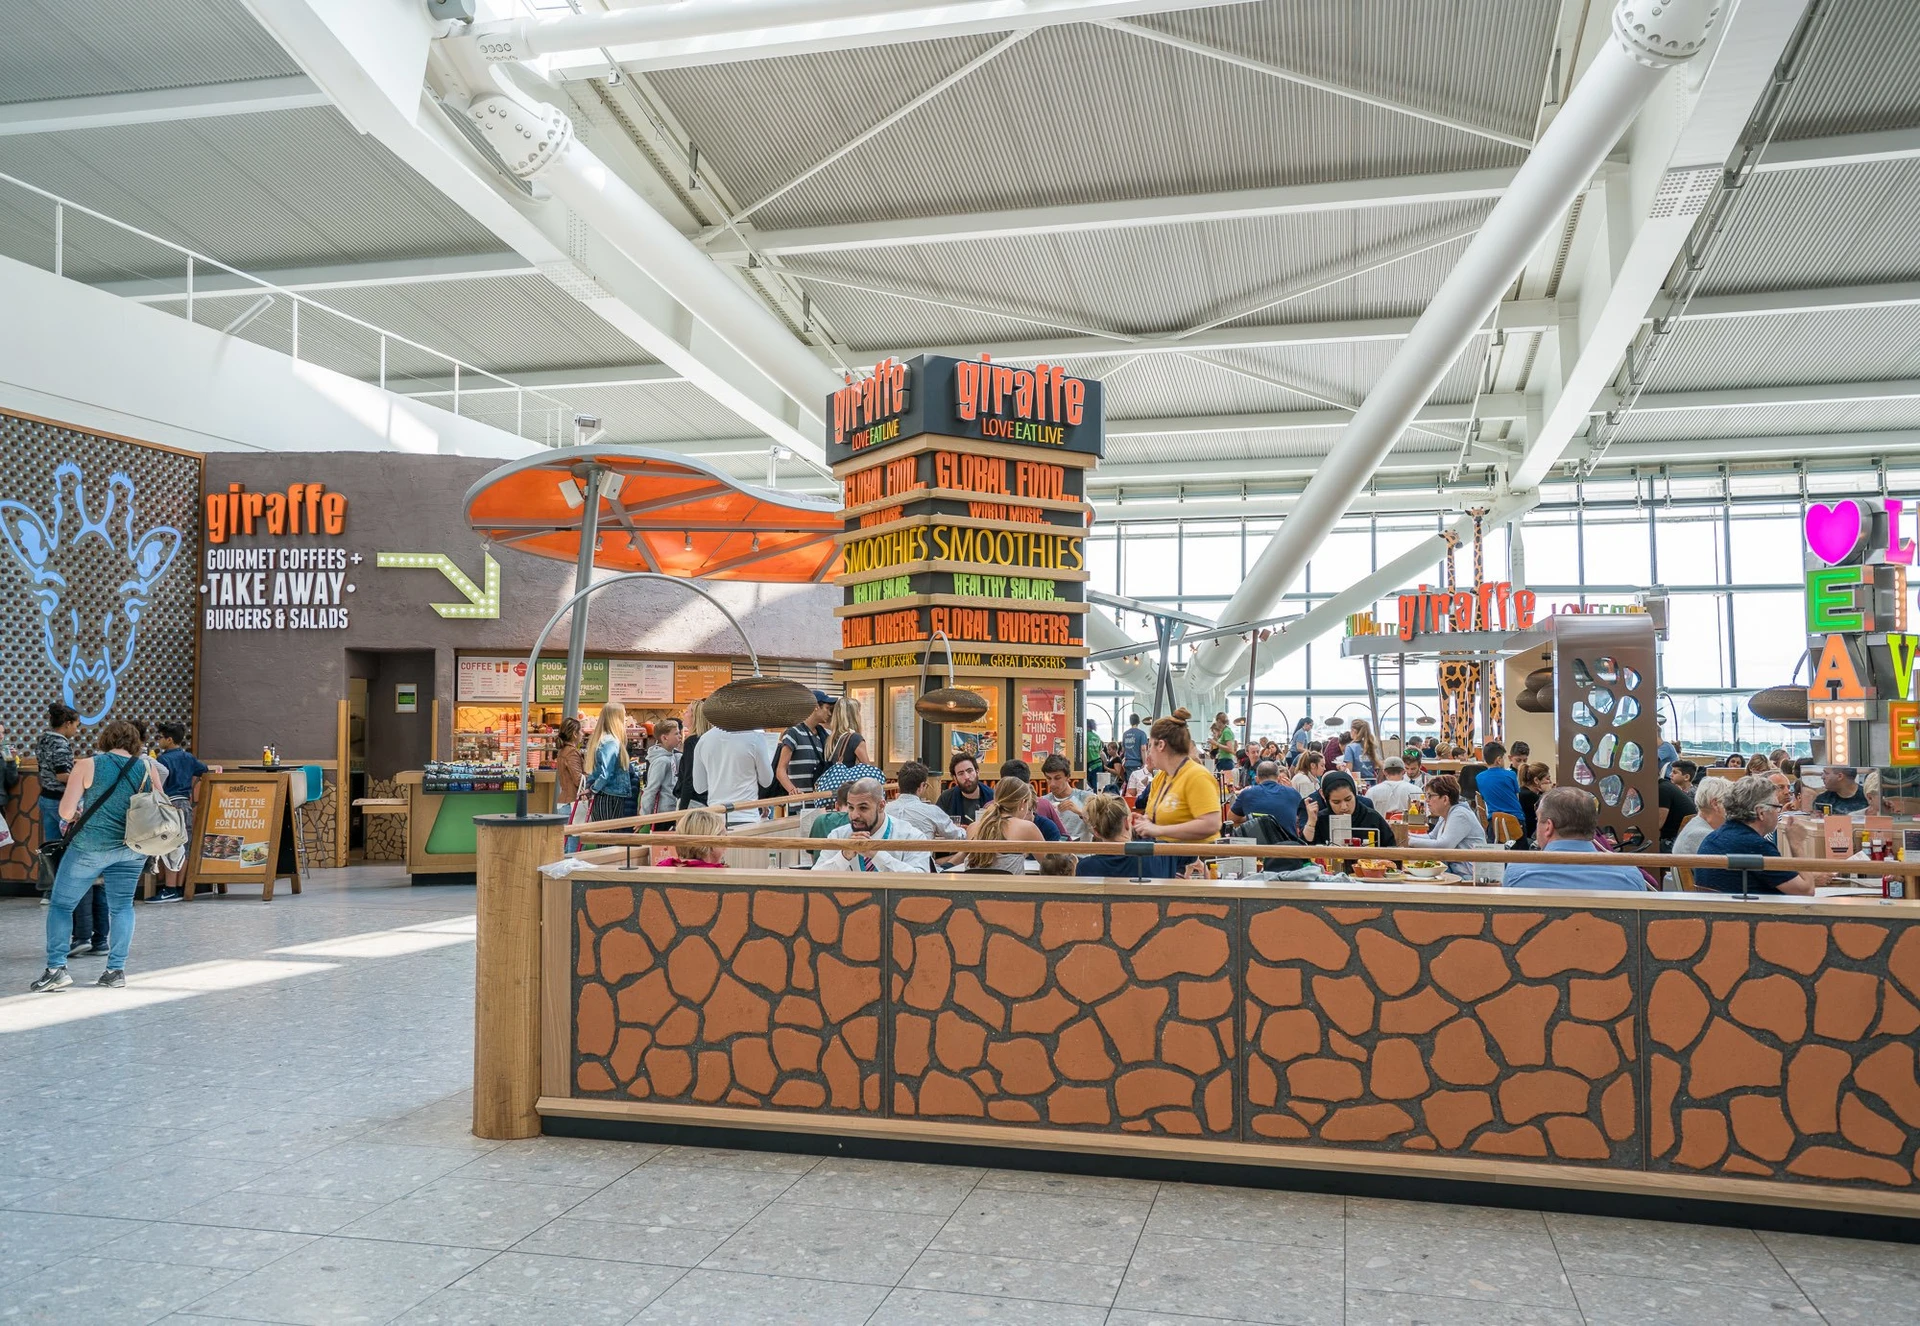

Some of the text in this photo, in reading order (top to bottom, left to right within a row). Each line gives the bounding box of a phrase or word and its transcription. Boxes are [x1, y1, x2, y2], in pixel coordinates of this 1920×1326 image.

[955, 352, 1086, 426] giraffe
[834, 357, 909, 444] giraffe
[935, 451, 1011, 496] GLOBAL
[845, 466, 884, 509] GLOBAL
[206, 482, 349, 544] giraffe
[968, 501, 1007, 520] WORLD
[207, 548, 276, 570] GOURMET
[279, 548, 347, 570] COFFEES
[843, 525, 929, 575] SMOOTHIES
[933, 525, 1084, 572] SMOOTHIES
[207, 572, 346, 606] TAKE AWAY
[853, 579, 882, 605] HEALTHY
[953, 573, 1007, 598] HEALTHY
[205, 608, 349, 630] BURGERS & SALADS
[1398, 581, 1537, 642] giraffe
[842, 615, 873, 649] GLOBAL
[930, 607, 1083, 646] GLOBAL BURGERS...
[460, 661, 492, 671] COFFEE
[541, 661, 604, 671] FOOD TO GO
[699, 665, 730, 673] SMOOTHIES
[871, 655, 889, 669] GREAT
[889, 653, 917, 668] DESSERTS
[990, 653, 1020, 668] GREAT
[1022, 655, 1067, 670] DESSERTS
[1026, 711, 1055, 722] SHAKE
[1025, 723, 1057, 733] THINGS
[1035, 734, 1048, 744] UP
[219, 798, 266, 808] MEET THE
[223, 808, 258, 819] WORLD
[215, 819, 265, 829] FOR LUNCH
